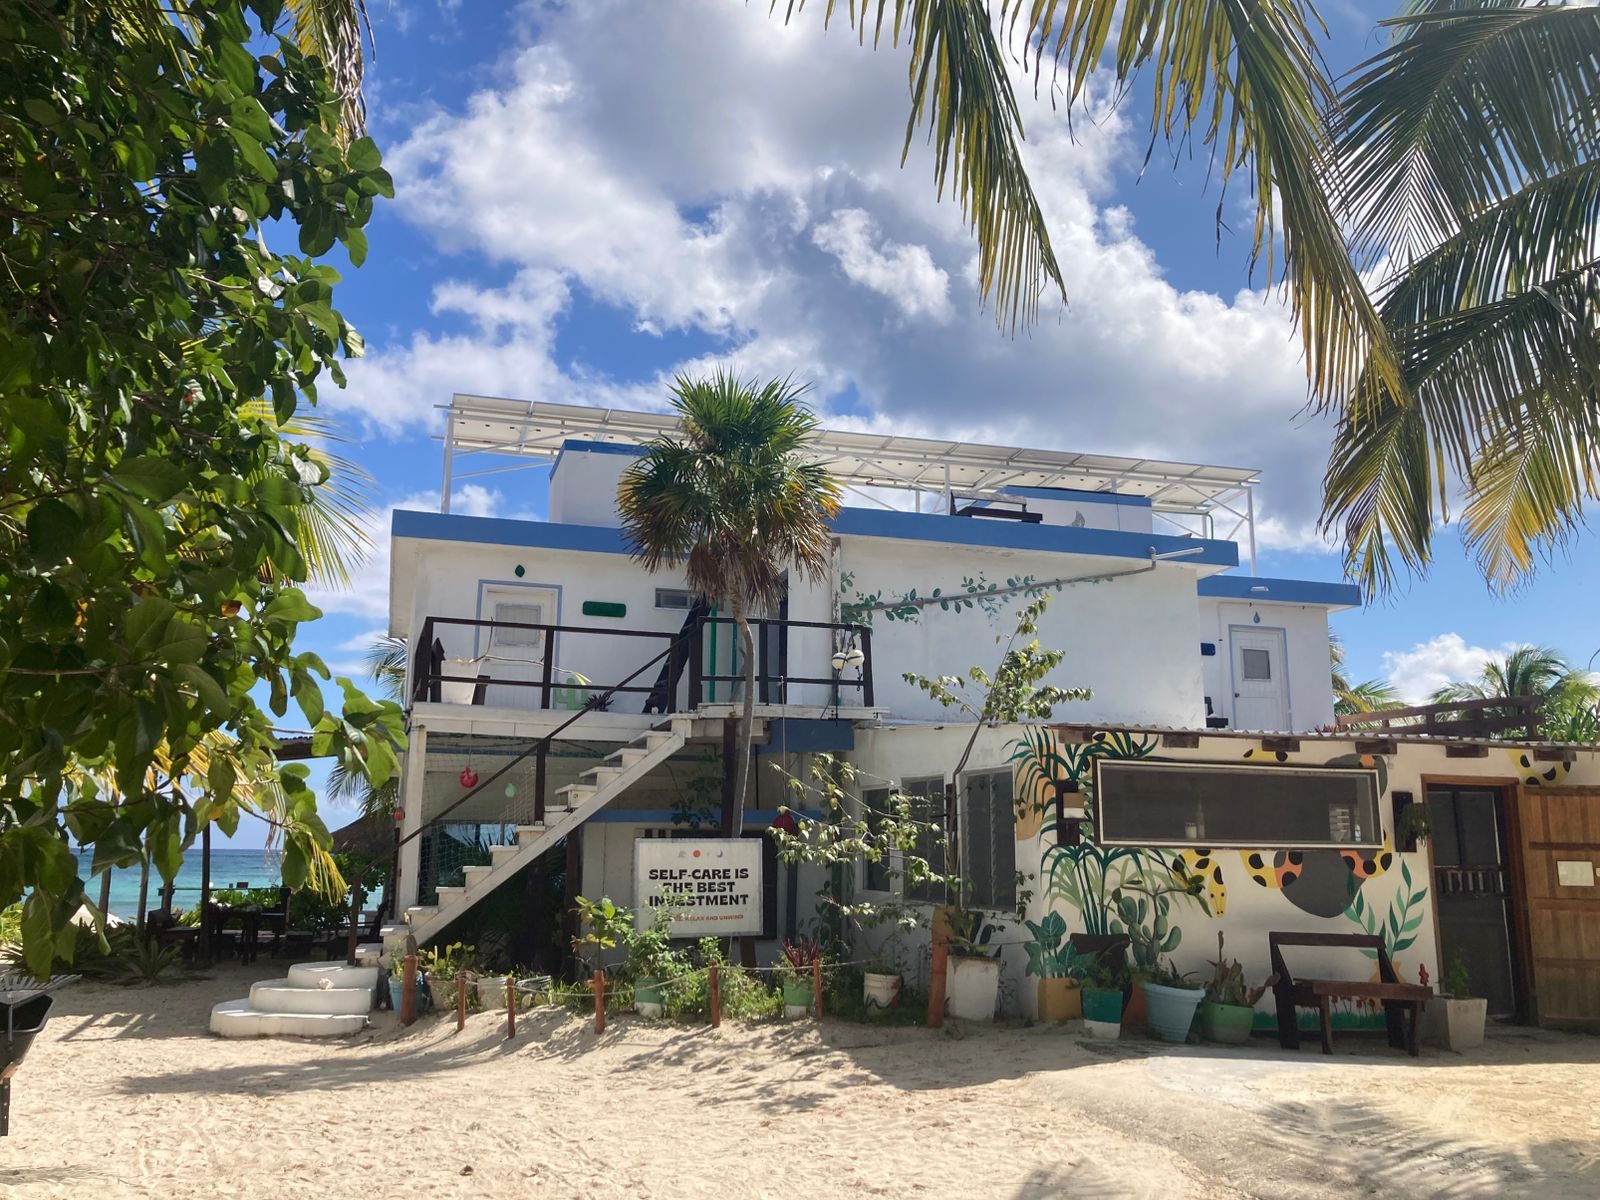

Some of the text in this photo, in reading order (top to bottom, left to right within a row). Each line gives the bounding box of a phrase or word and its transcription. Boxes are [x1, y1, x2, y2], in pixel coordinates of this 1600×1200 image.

[649, 868, 749, 880] SELF-CARE IS
[662, 881, 736, 893] THE BEST
